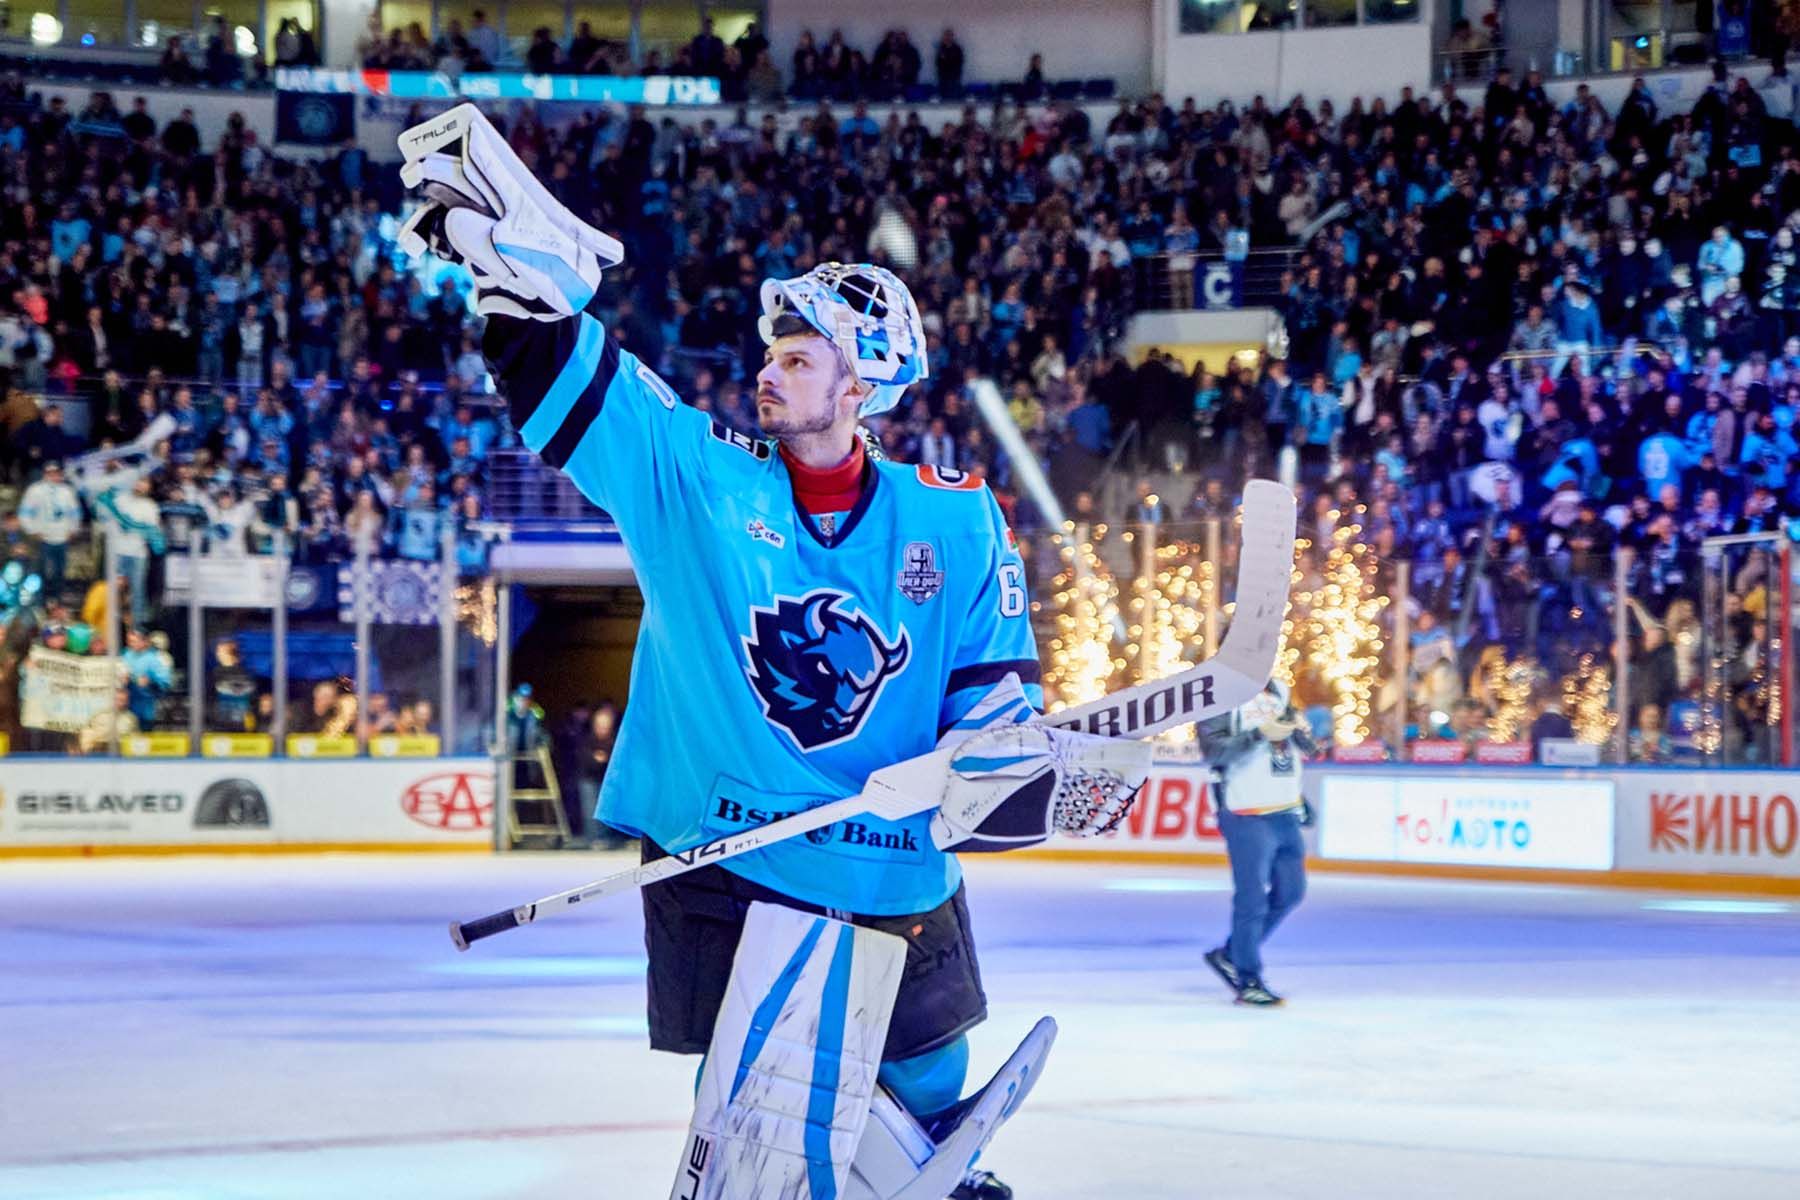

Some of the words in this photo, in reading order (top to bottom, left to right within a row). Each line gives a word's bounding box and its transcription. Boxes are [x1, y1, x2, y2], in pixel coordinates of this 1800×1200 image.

[409, 119, 458, 146] TRUE
[998, 563, 1026, 618] 6
[17, 794, 184, 814] GISLAVED
[838, 820, 919, 852] Bank
[1650, 793, 1798, 857] КИНО
